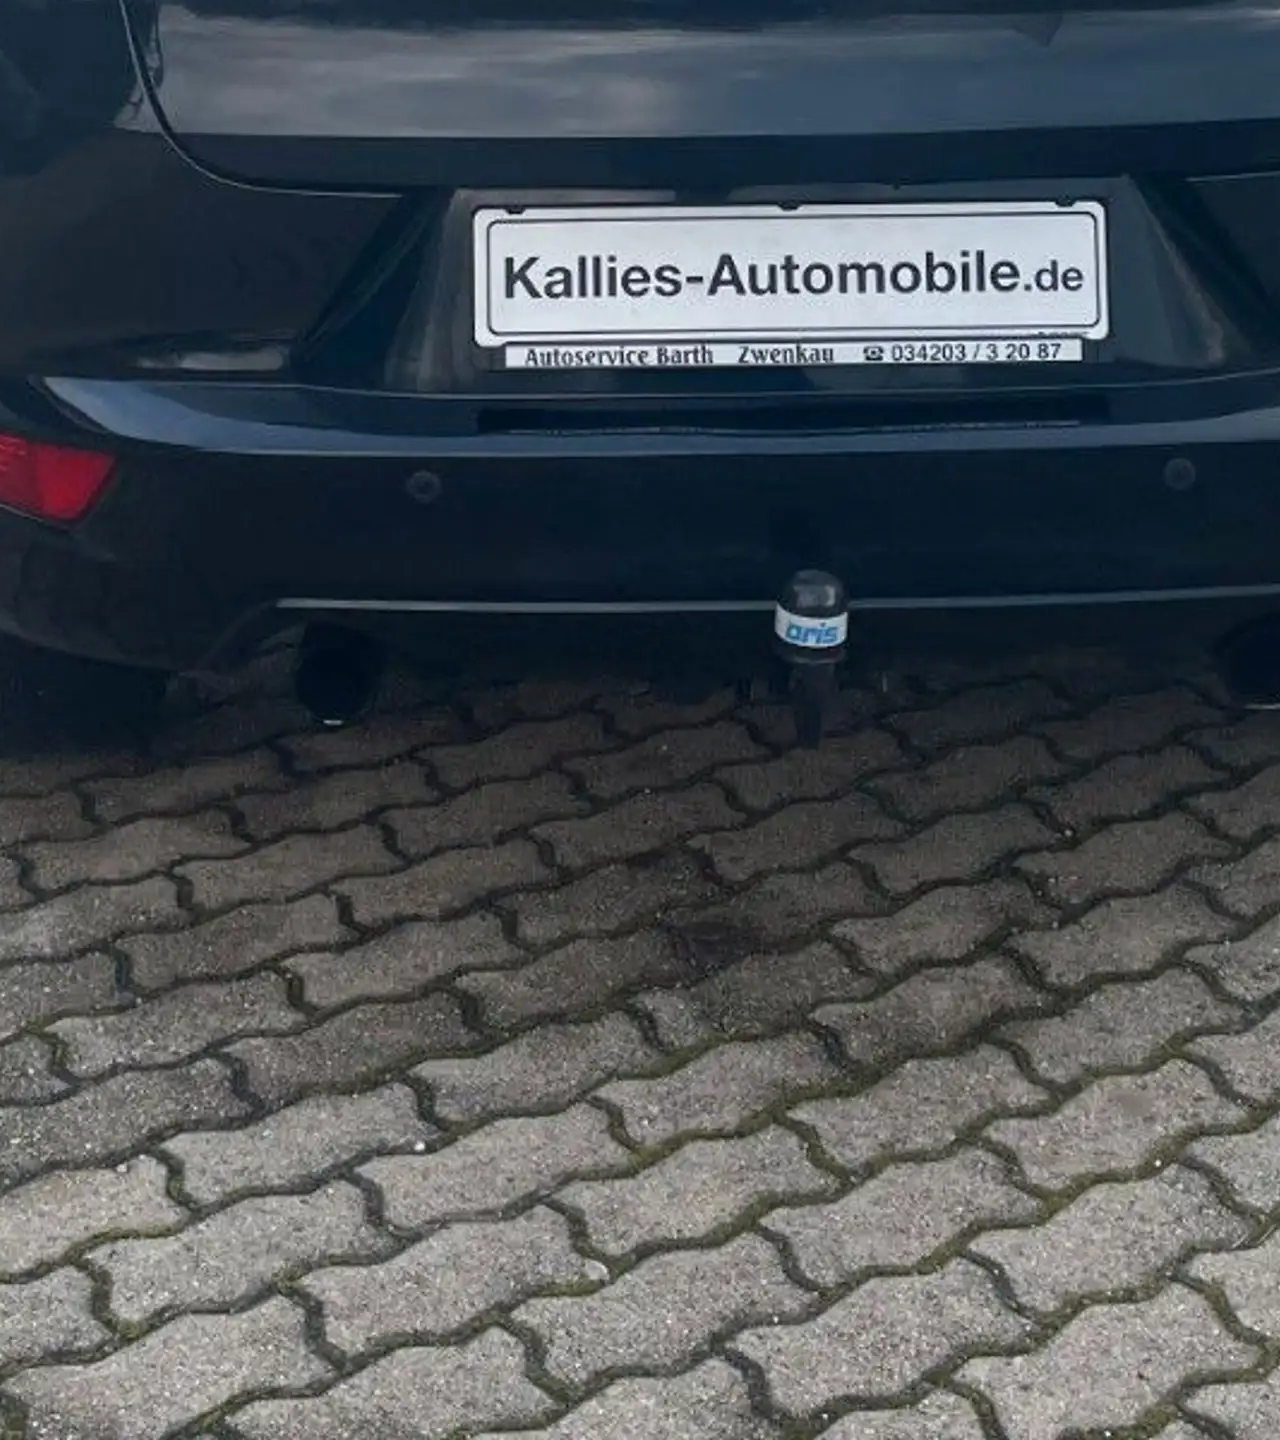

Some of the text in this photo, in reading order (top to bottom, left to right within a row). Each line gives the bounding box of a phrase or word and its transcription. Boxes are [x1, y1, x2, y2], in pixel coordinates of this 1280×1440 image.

[503, 249, 1085, 300] Kallies-Automobile.de
[524, 346, 650, 367] Autoservice
[656, 344, 715, 366] Barth
[737, 343, 835, 365] Zwenkau
[890, 342, 967, 362] 034203
[985, 343, 1000, 361] 3
[1004, 342, 1031, 361] 20
[1037, 341, 1062, 360] 87
